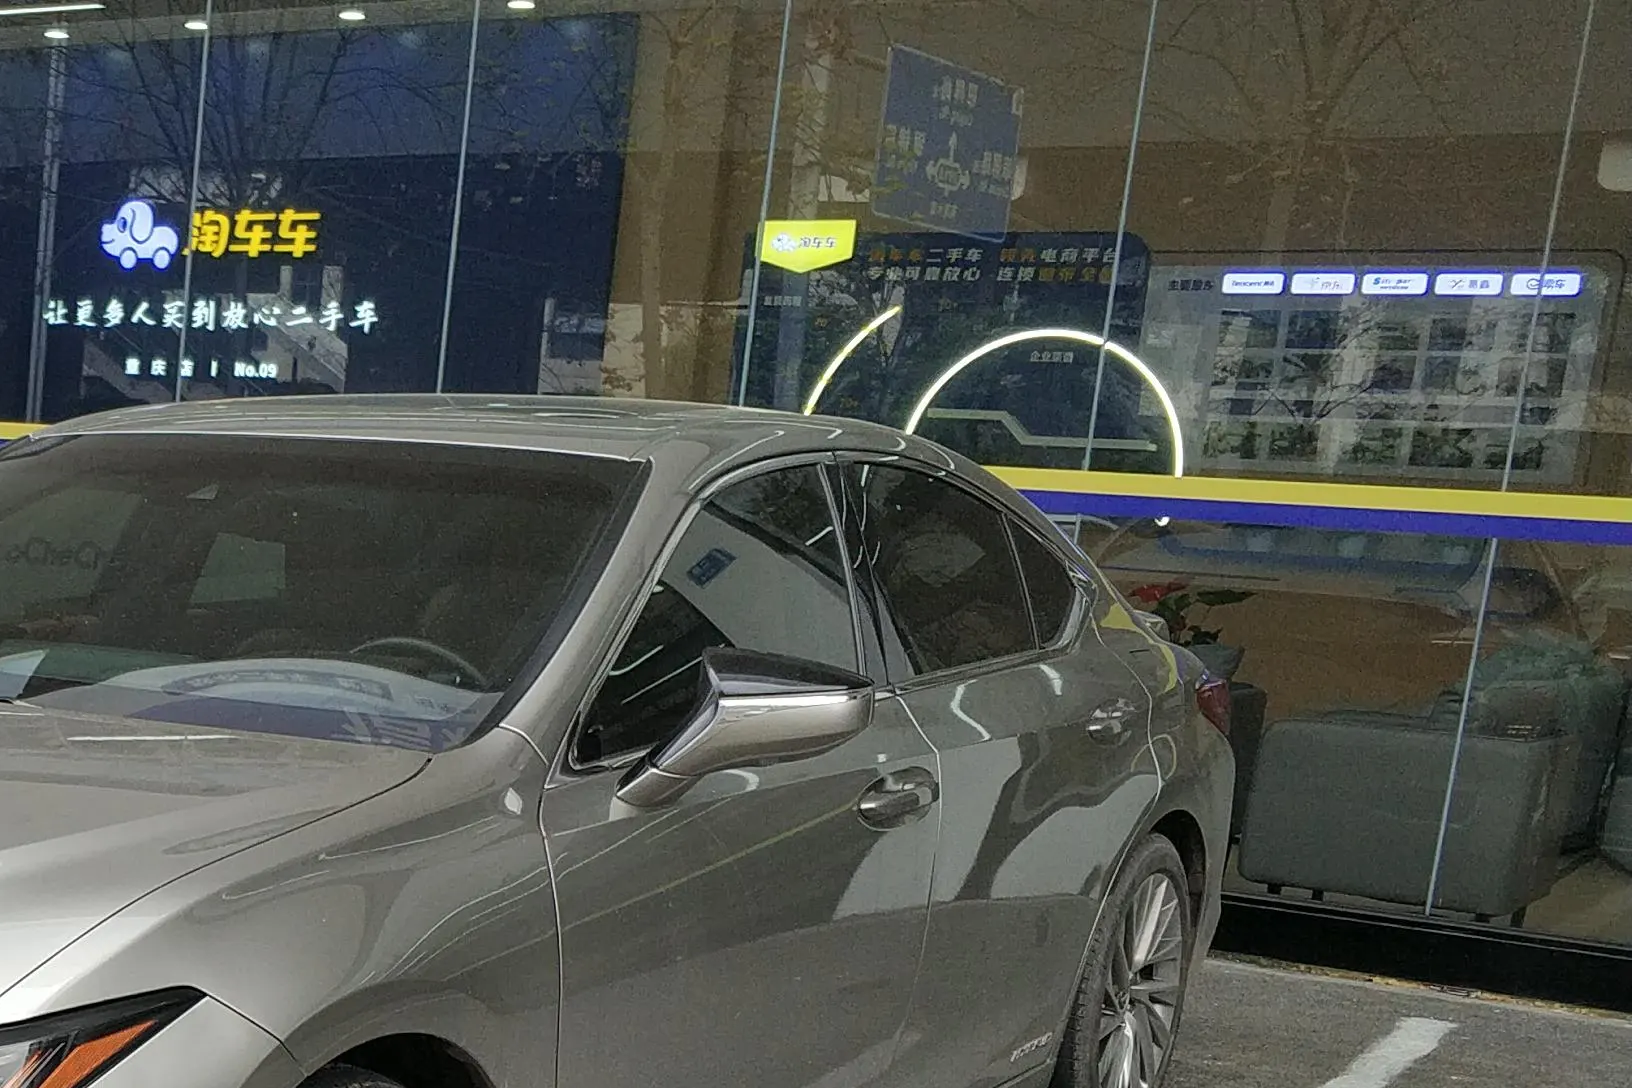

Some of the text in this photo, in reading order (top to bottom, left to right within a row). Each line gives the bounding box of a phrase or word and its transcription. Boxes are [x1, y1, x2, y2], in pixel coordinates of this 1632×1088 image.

[182, 209, 321, 258] 淘车车
[43, 299, 379, 334] 让更多人买到放心二手车
[233, 362, 278, 378] No.09
